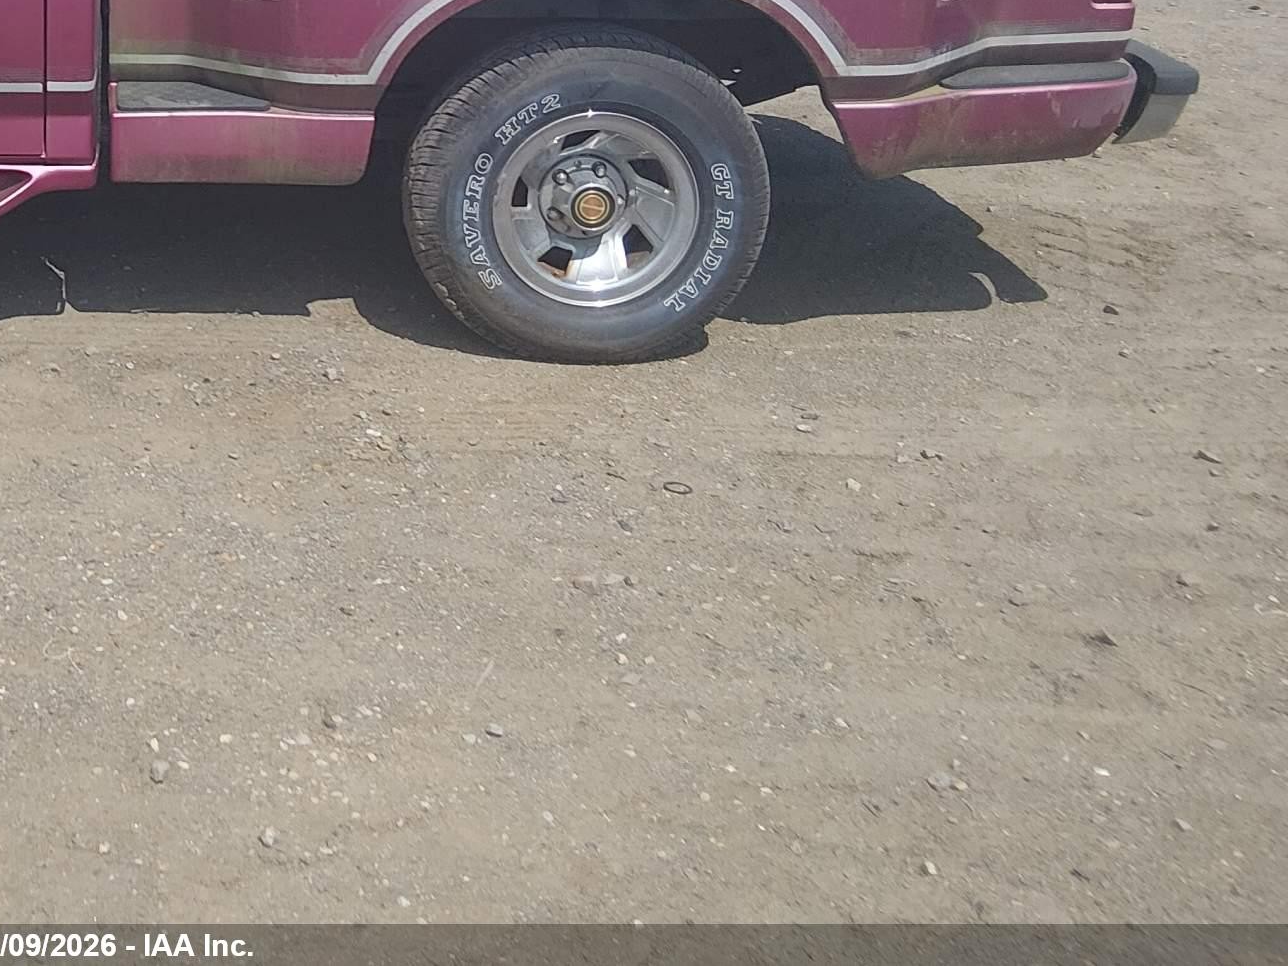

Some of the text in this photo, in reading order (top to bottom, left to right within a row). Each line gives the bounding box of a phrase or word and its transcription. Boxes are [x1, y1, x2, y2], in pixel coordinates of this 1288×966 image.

[462, 93, 562, 290] SAVERO HT2
[663, 162, 735, 312] GT RADIAL
